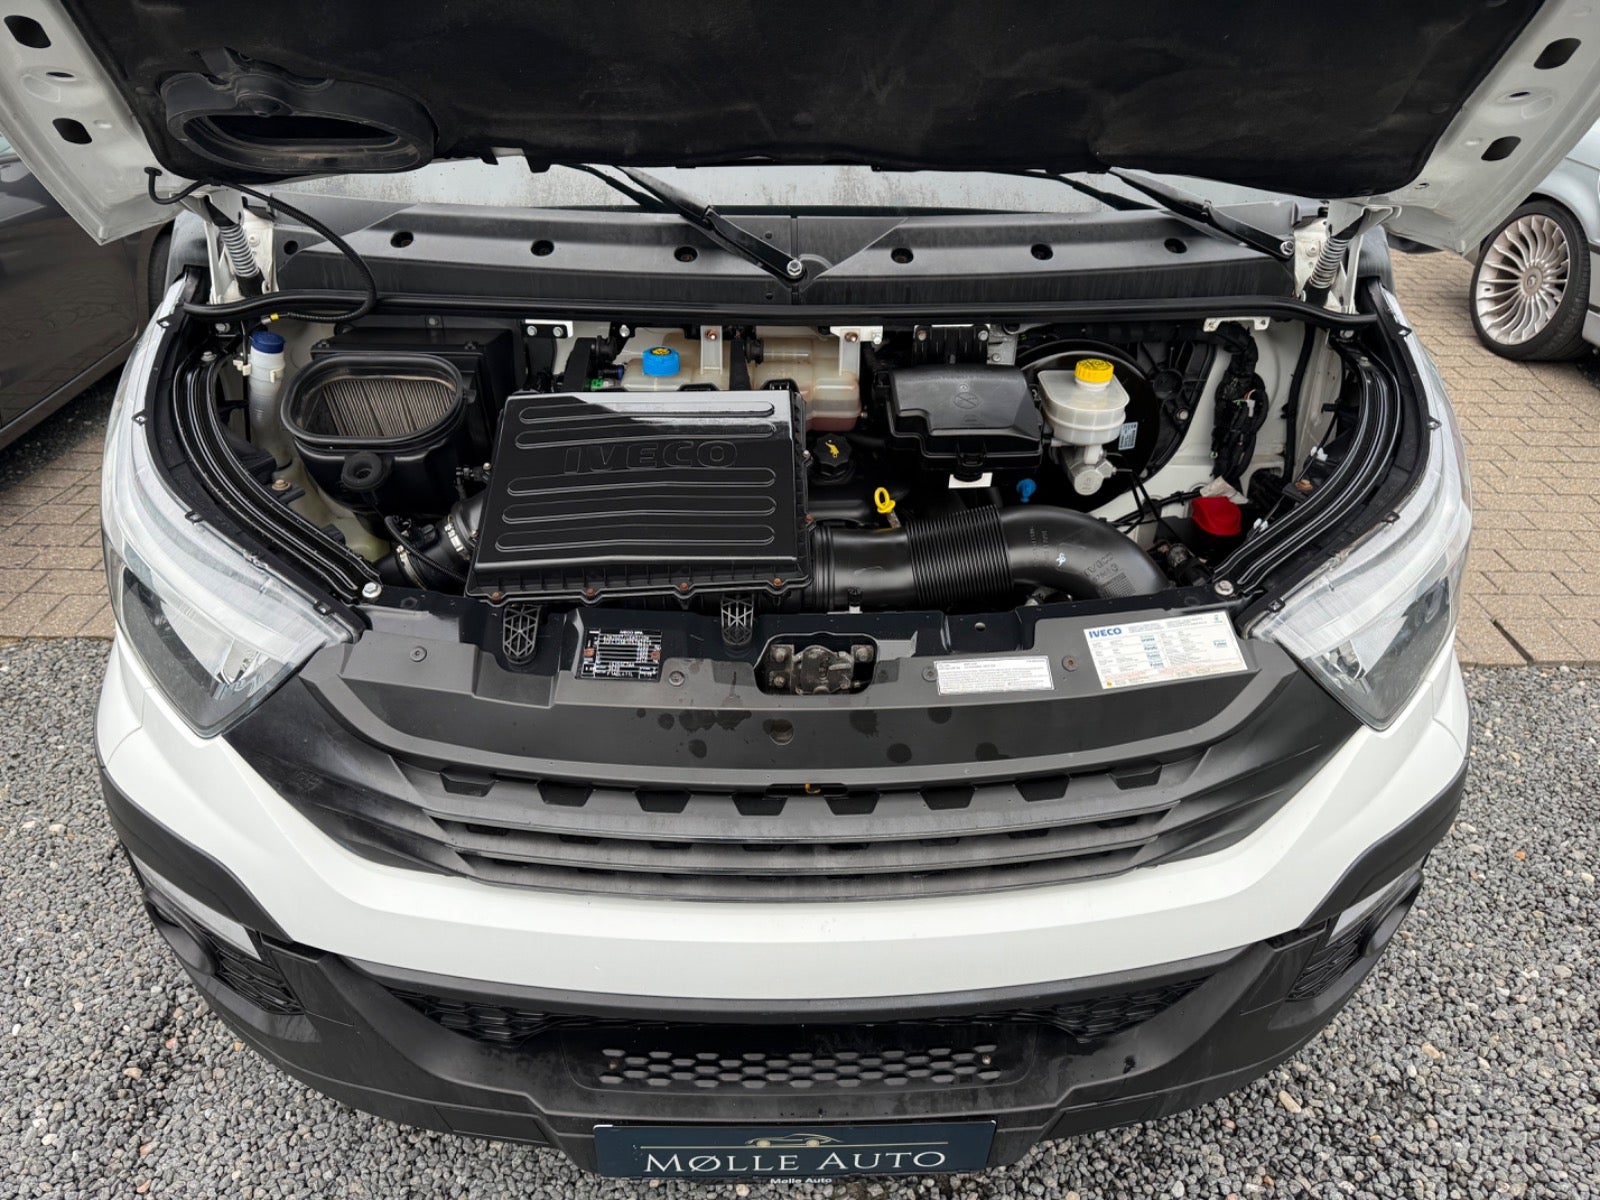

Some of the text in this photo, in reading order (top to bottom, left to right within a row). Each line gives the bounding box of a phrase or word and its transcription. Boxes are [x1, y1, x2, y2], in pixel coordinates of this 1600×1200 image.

[564, 440, 737, 475] IVECO
[1088, 627, 1122, 639] IVECO
[645, 1150, 946, 1172] MØLLE AUTO
